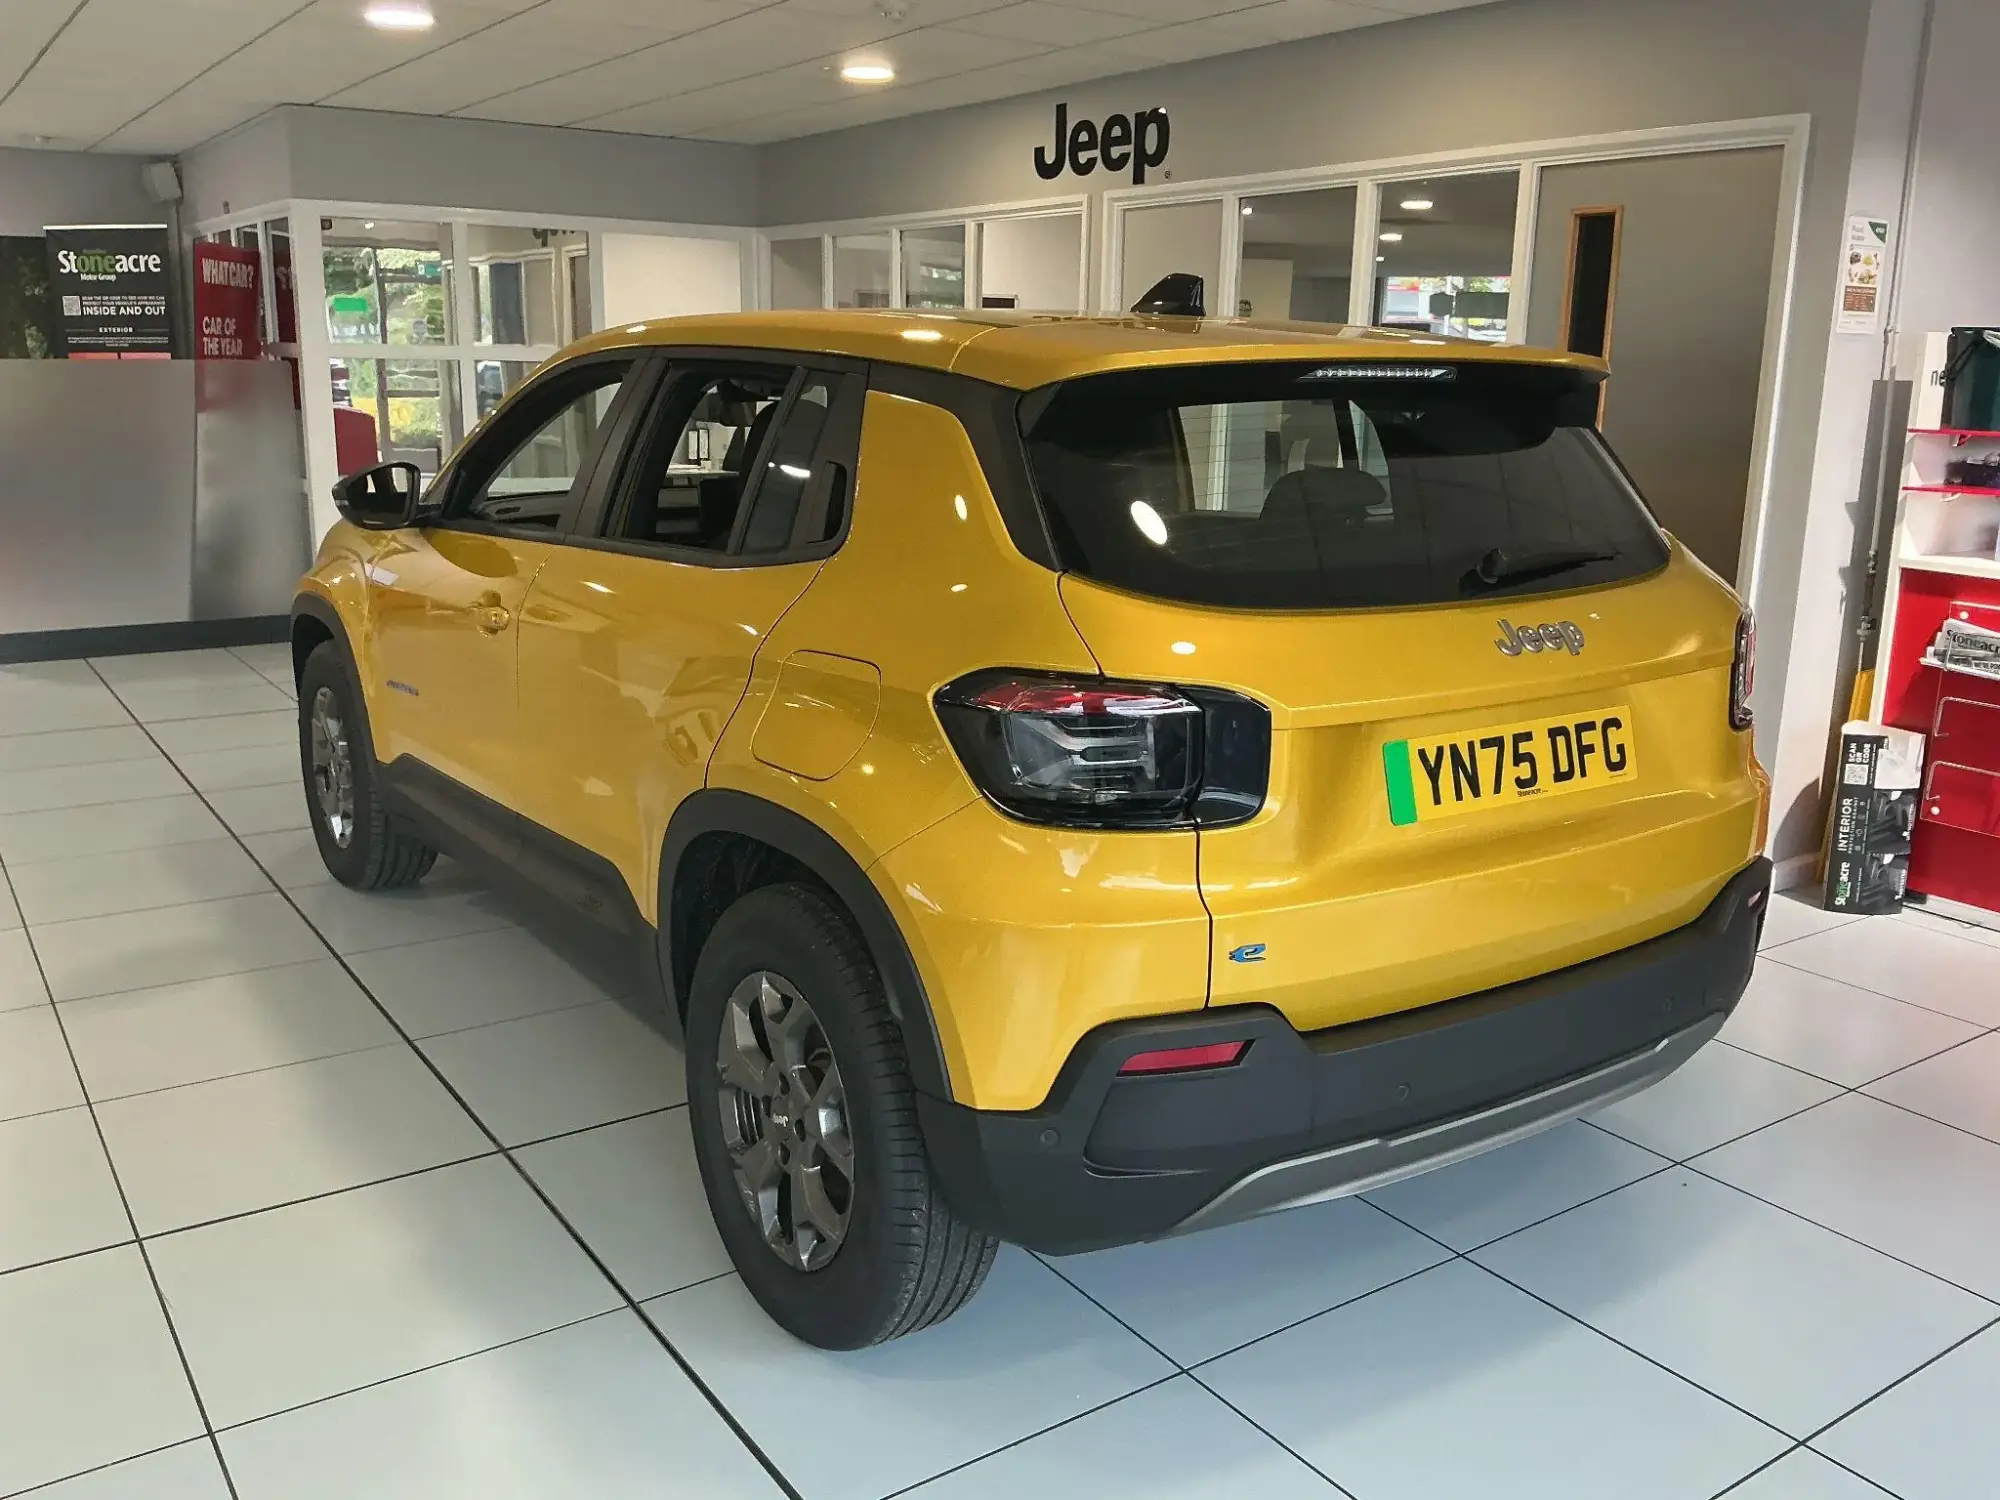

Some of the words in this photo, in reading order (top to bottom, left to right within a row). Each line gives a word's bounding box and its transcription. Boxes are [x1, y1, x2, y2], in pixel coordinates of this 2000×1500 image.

[1034, 103, 1171, 185] Jeep
[57, 249, 162, 274] Stoneacre
[83, 306, 117, 316] INSIDE
[119, 306, 142, 316] AND
[144, 306, 166, 316] OUT
[202, 316, 222, 335] CAR
[224, 317, 236, 336] OF
[203, 336, 219, 356] THE
[220, 338, 243, 356] YEAR
[1494, 618, 1585, 657] Jeep
[1417, 730, 1539, 806] YN75
[1547, 716, 1628, 784] DFG
[1847, 742, 1857, 763] SCAN
[1862, 742, 1871, 764] CODE
[1837, 797, 1853, 852] INTERIOR
[1834, 861, 1851, 906] Stoneacre
